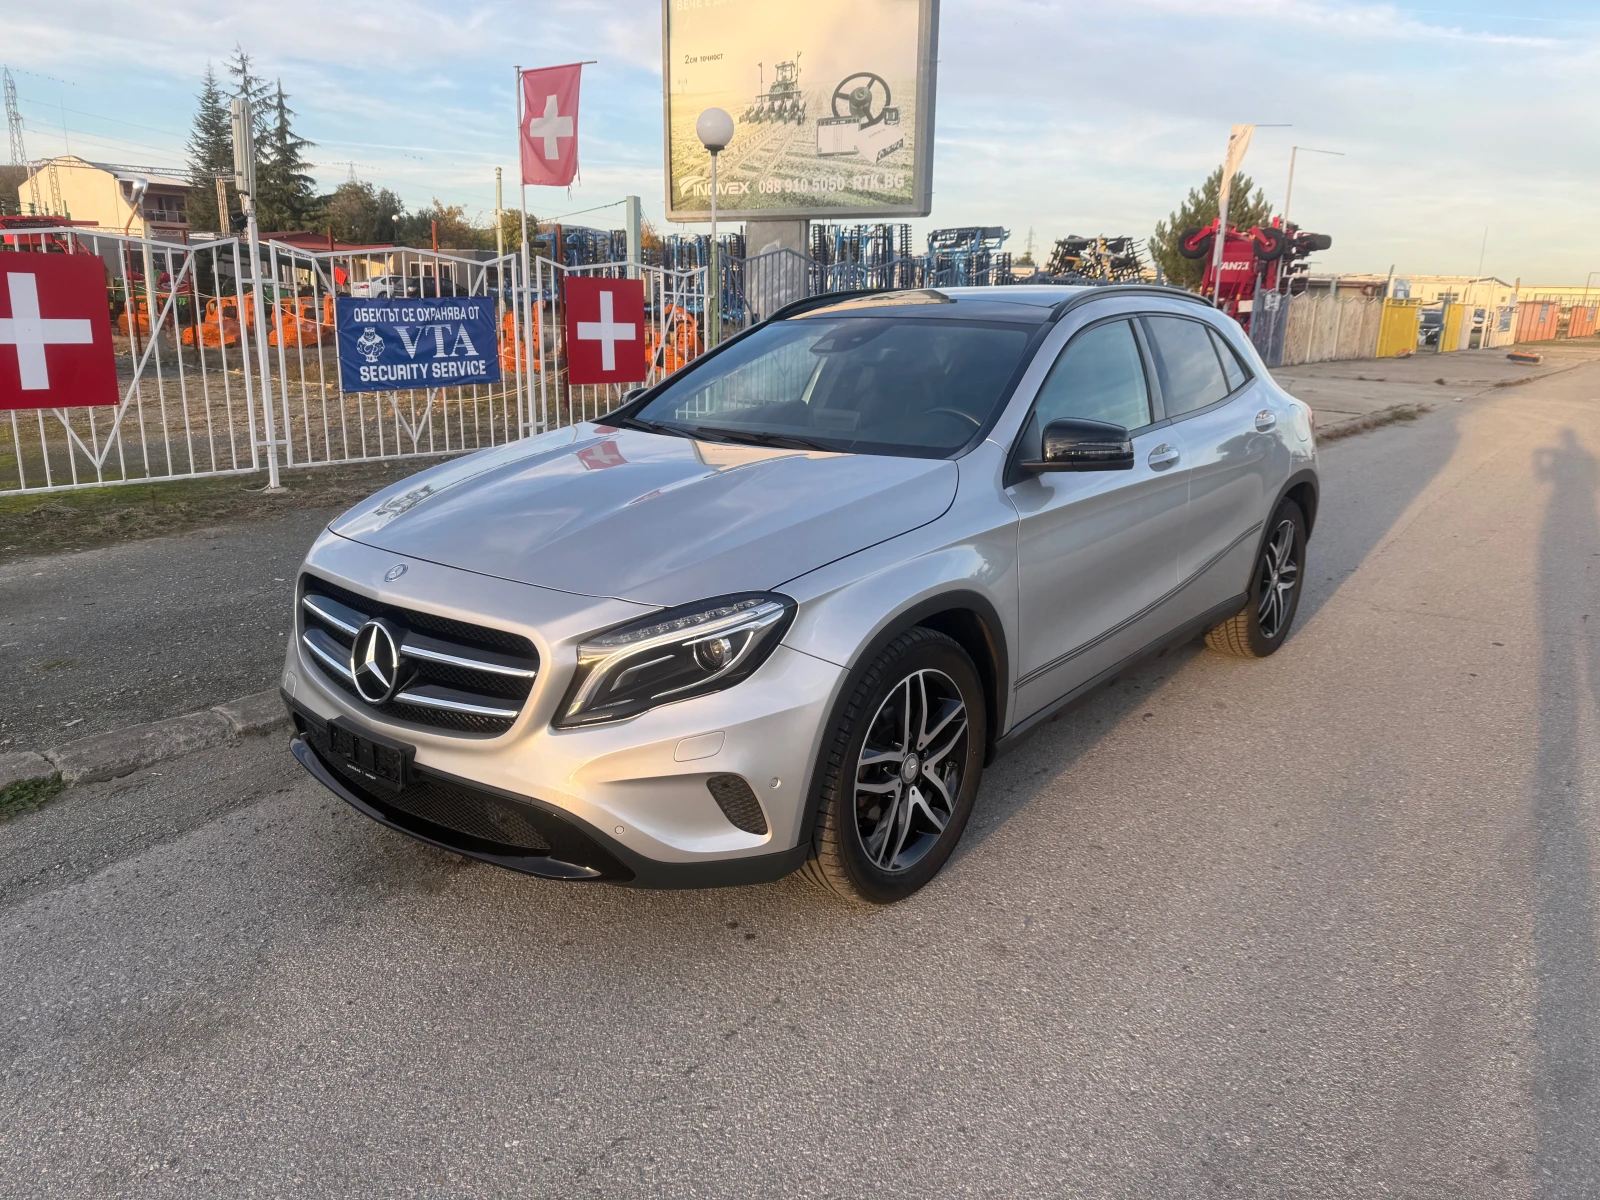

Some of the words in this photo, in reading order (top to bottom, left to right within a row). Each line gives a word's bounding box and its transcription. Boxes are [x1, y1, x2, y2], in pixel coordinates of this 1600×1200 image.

[759, 179, 782, 194] 088
[784, 178, 809, 193] 910
[811, 176, 846, 192] 5050
[852, 172, 905, 191] RTK.BG
[353, 308, 400, 323] ОБЕКТЪТ
[402, 307, 416, 322] СЕ
[416, 306, 468, 322] ОХРАНЯВА
[468, 306, 480, 320] ОТ
[393, 323, 480, 359] VTA
[359, 363, 429, 382] SECURITY
[432, 360, 487, 378] SERVICE
